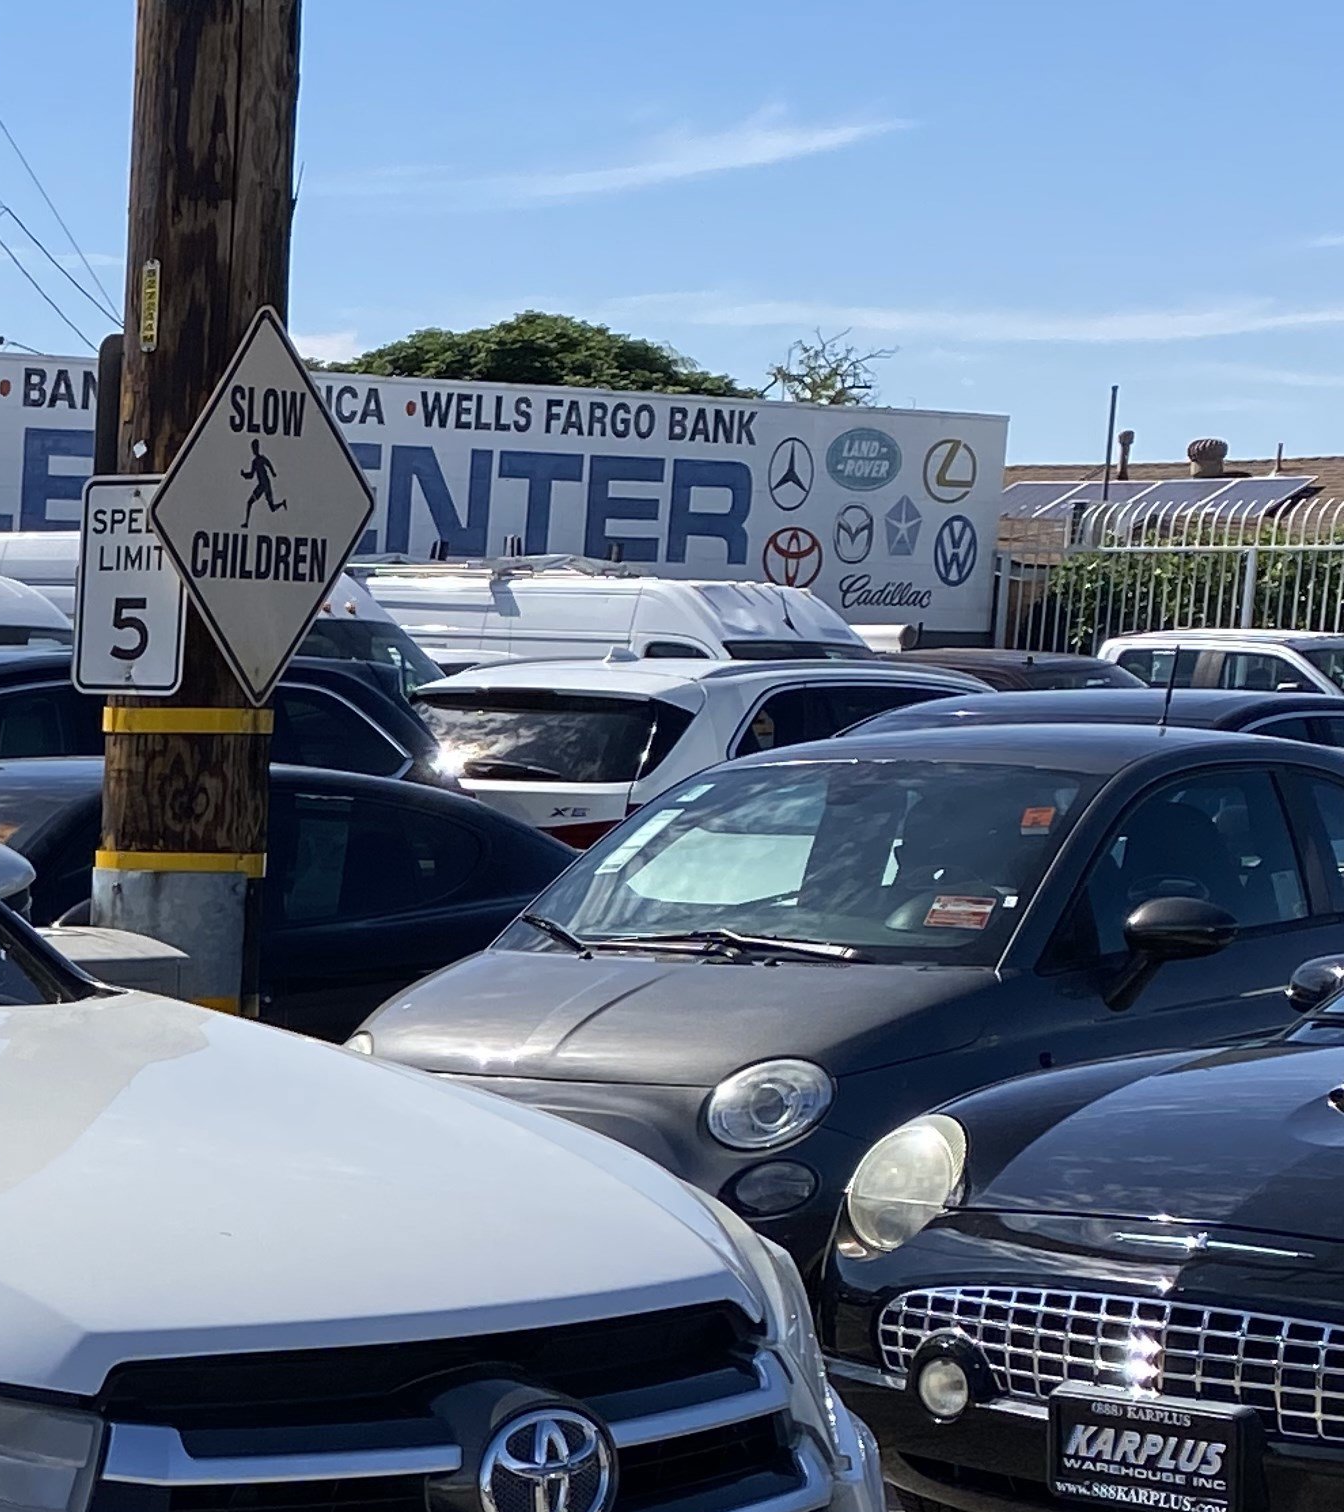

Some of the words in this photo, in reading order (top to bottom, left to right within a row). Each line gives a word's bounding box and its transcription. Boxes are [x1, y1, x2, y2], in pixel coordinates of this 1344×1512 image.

[229, 384, 307, 438] SLOW
[420, 390, 533, 433] WELLS
[544, 398, 656, 440] FARGO
[668, 405, 759, 446] BANK
[98, 545, 165, 572] LIMIT
[190, 530, 328, 584] CHILDREN
[838, 573, 933, 609] Cadillac
[109, 597, 149, 661] 5
[1125, 1405, 1193, 1428] KARPLUS
[1062, 1456, 1187, 1486] WAREHOUSE
[1192, 1476, 1227, 1491] INC
[1065, 1423, 1227, 1476] KARPLUS
